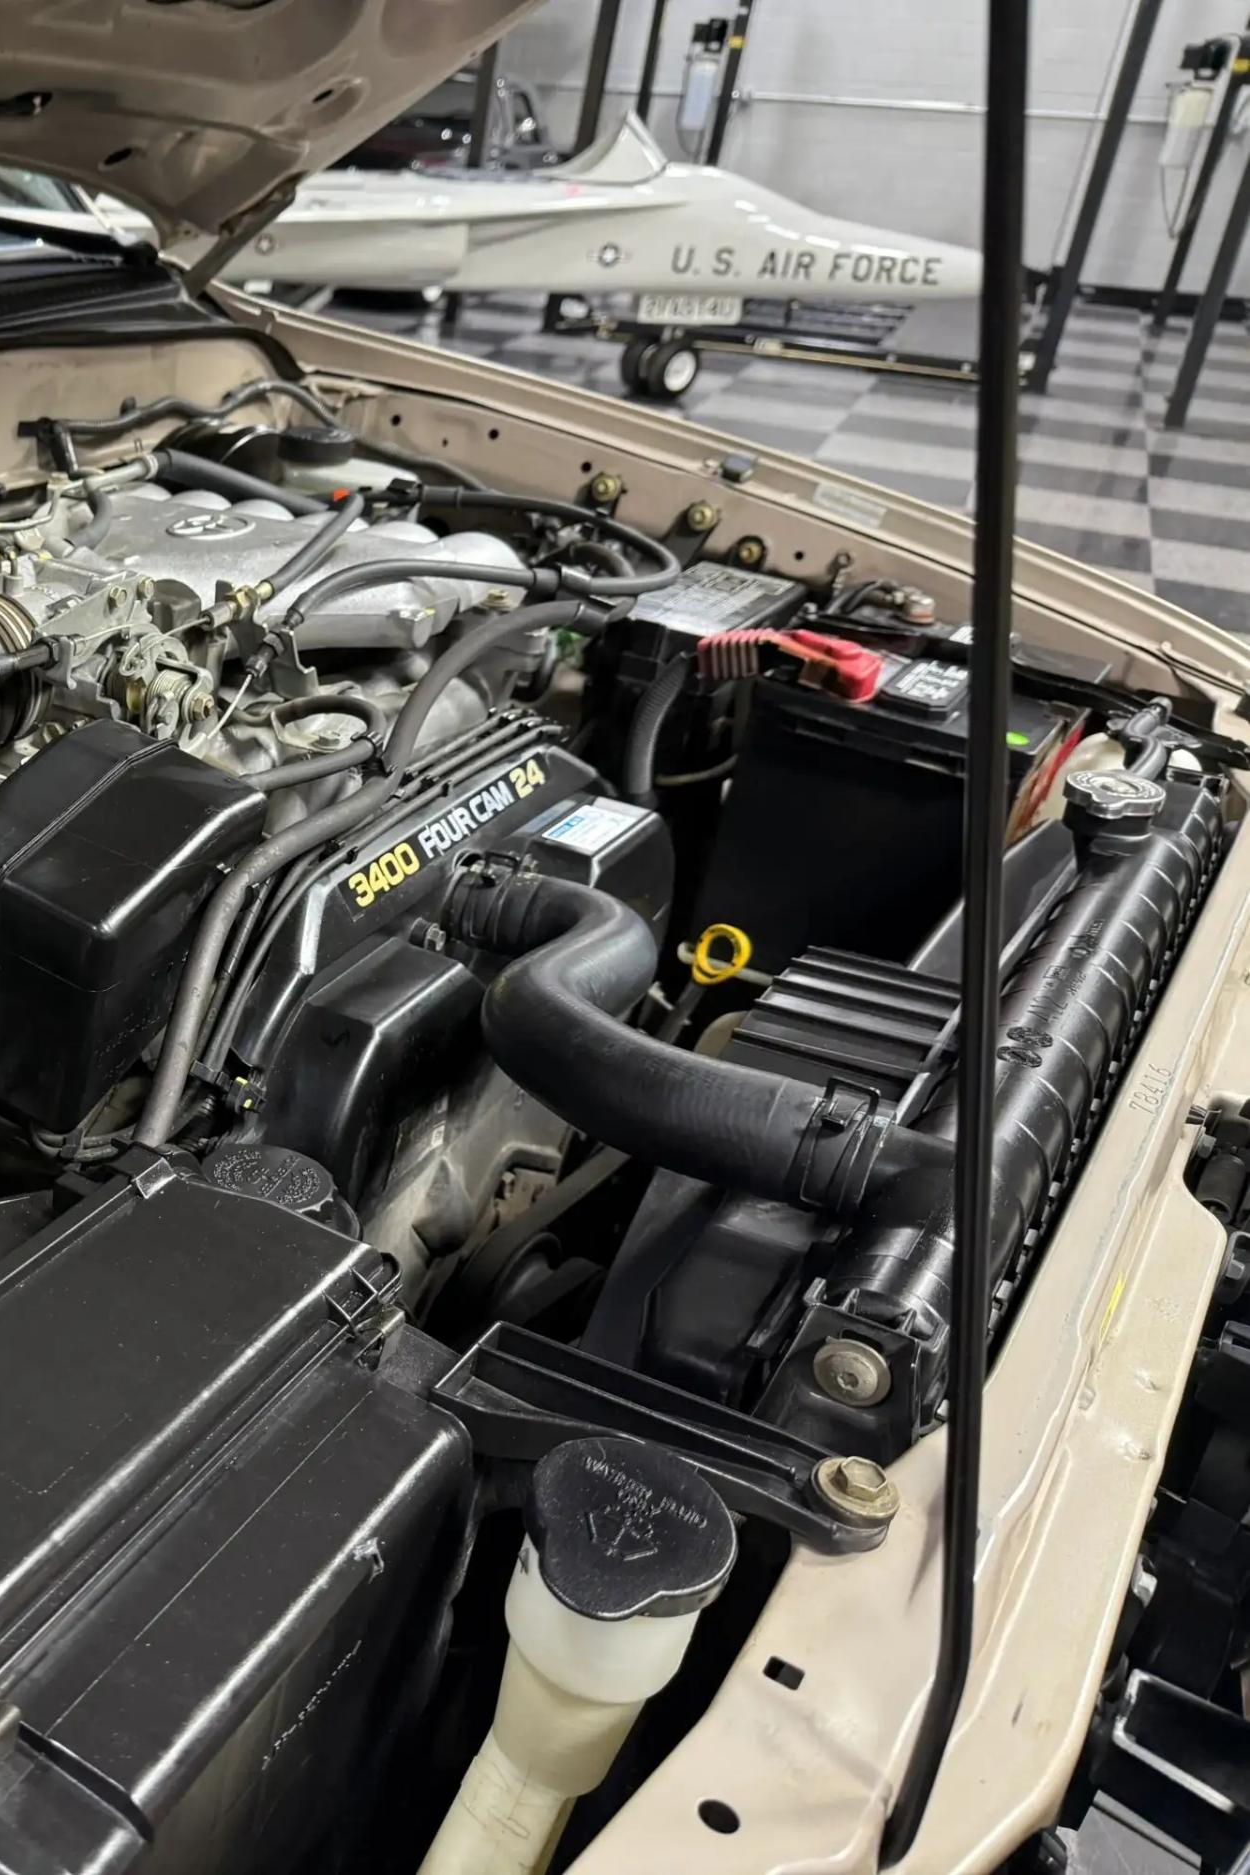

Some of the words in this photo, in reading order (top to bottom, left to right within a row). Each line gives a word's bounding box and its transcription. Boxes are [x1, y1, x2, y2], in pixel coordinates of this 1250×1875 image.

[671, 246, 699, 276] U.
[712, 248, 741, 278] S.
[757, 248, 815, 281] AIR
[828, 252, 943, 287] FORCE
[348, 842, 421, 908] 3400
[417, 807, 473, 859] FOUR
[468, 780, 517, 823] CAM
[508, 759, 545, 799] 24
